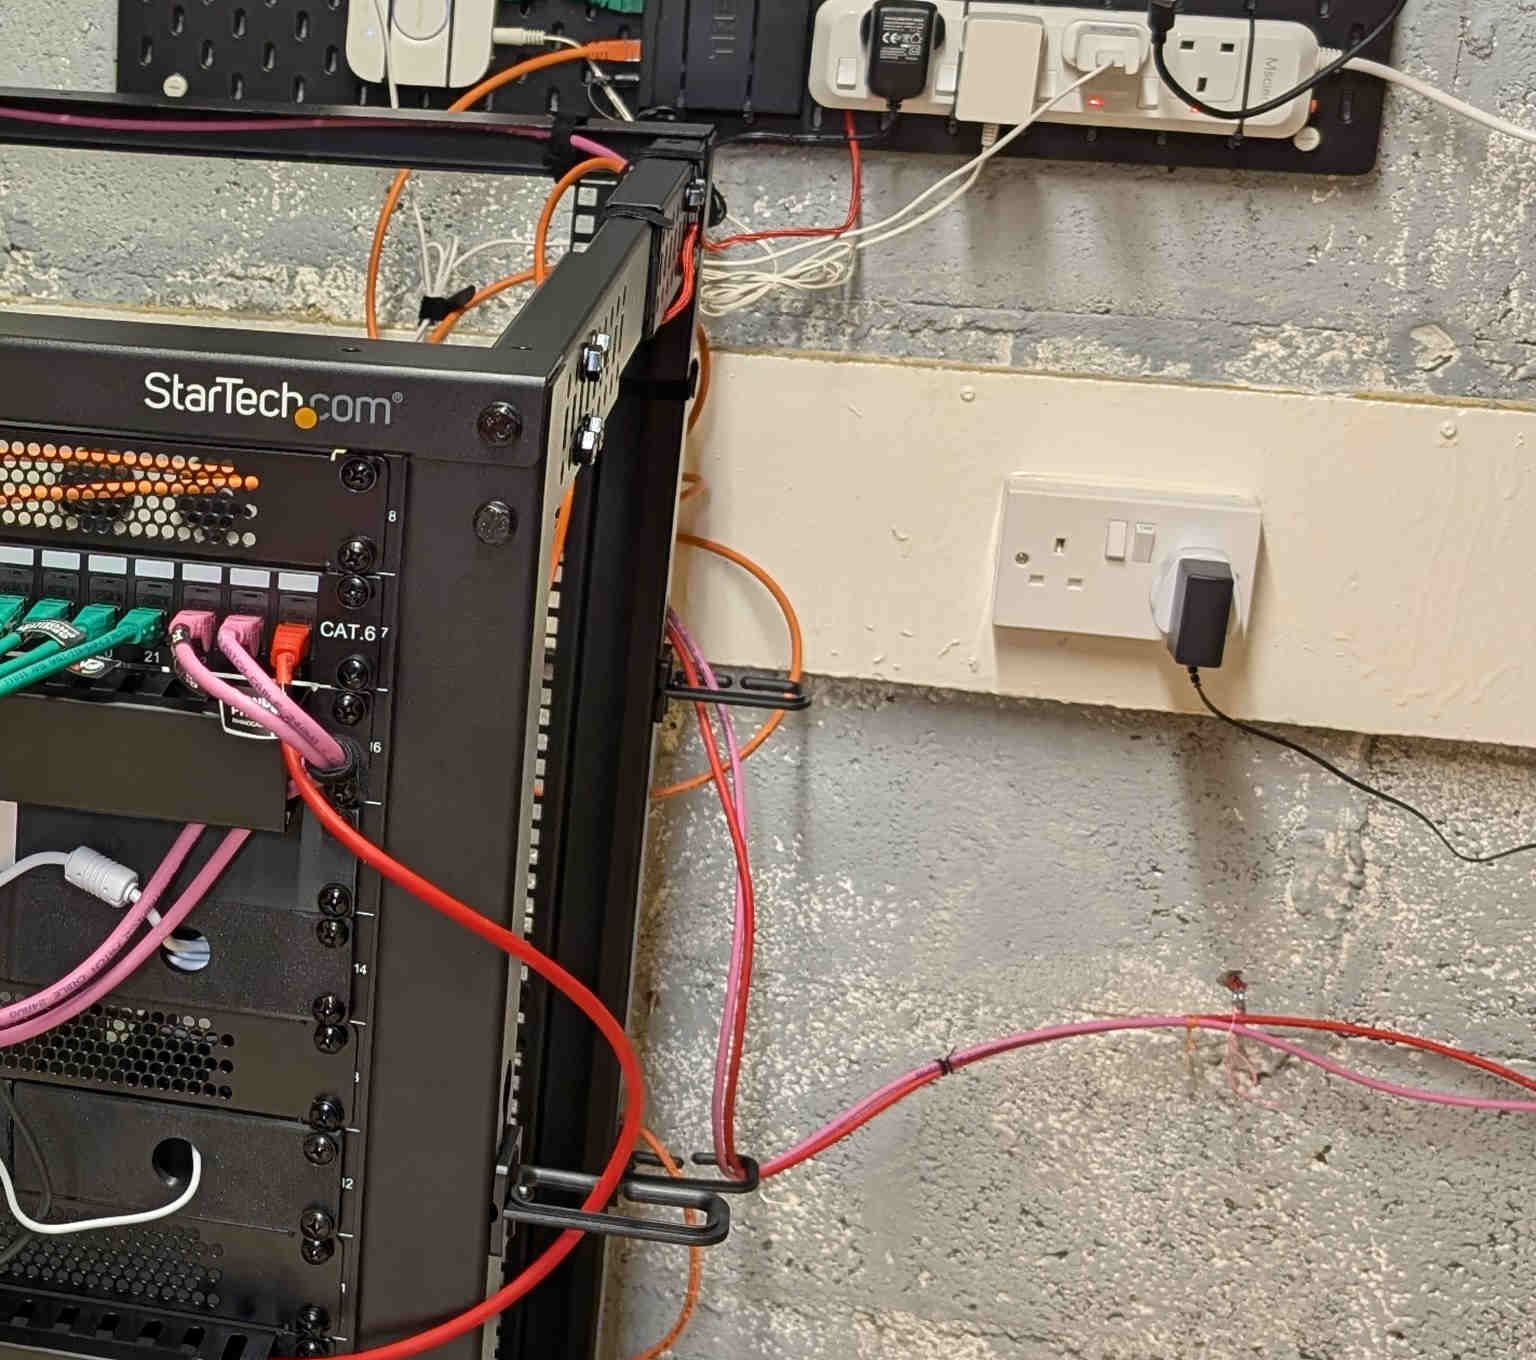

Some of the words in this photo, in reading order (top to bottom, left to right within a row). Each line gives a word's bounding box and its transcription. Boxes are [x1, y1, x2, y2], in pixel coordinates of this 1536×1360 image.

[319, 620, 376, 642] CAT.6
[143, 650, 161, 664] 21
[353, 962, 367, 976] 14
